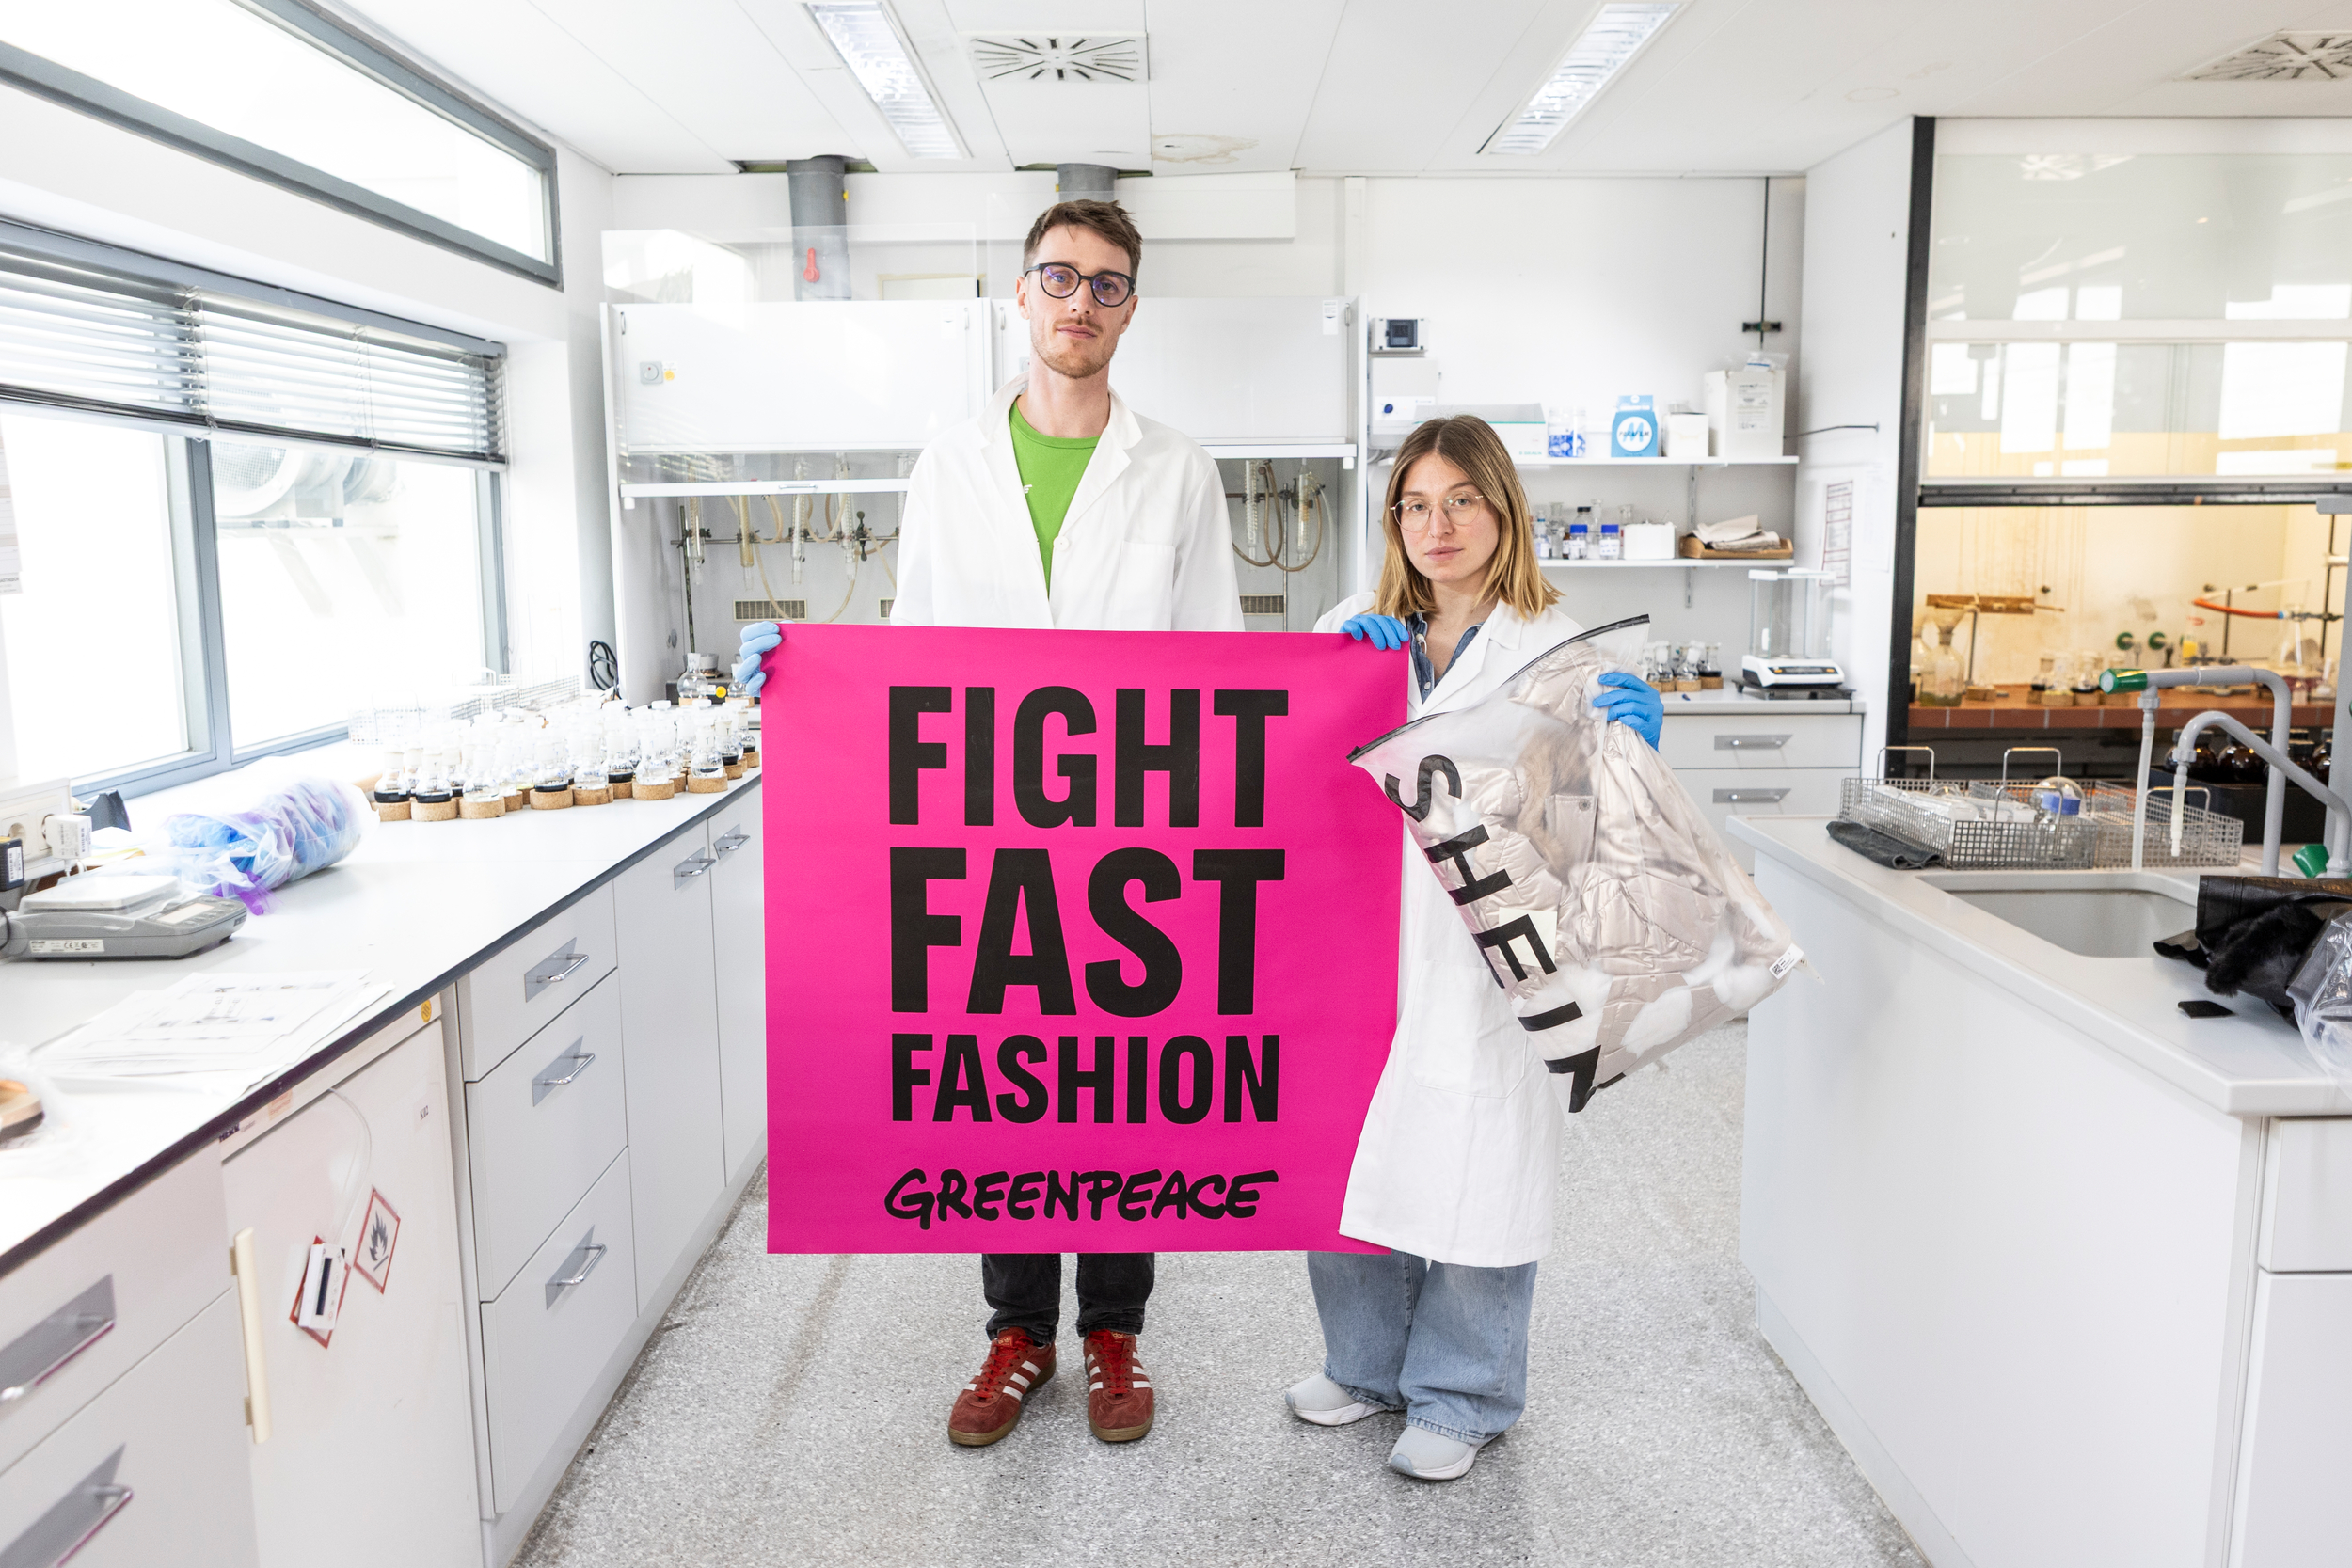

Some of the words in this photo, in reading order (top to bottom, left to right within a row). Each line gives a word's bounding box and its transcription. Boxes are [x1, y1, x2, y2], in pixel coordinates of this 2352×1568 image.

[889, 686, 1289, 829] FIGHT
[890, 847, 1287, 1018] FAST
[892, 1033, 1280, 1125] FASHION
[884, 1168, 1279, 1230] GREENPEACE
